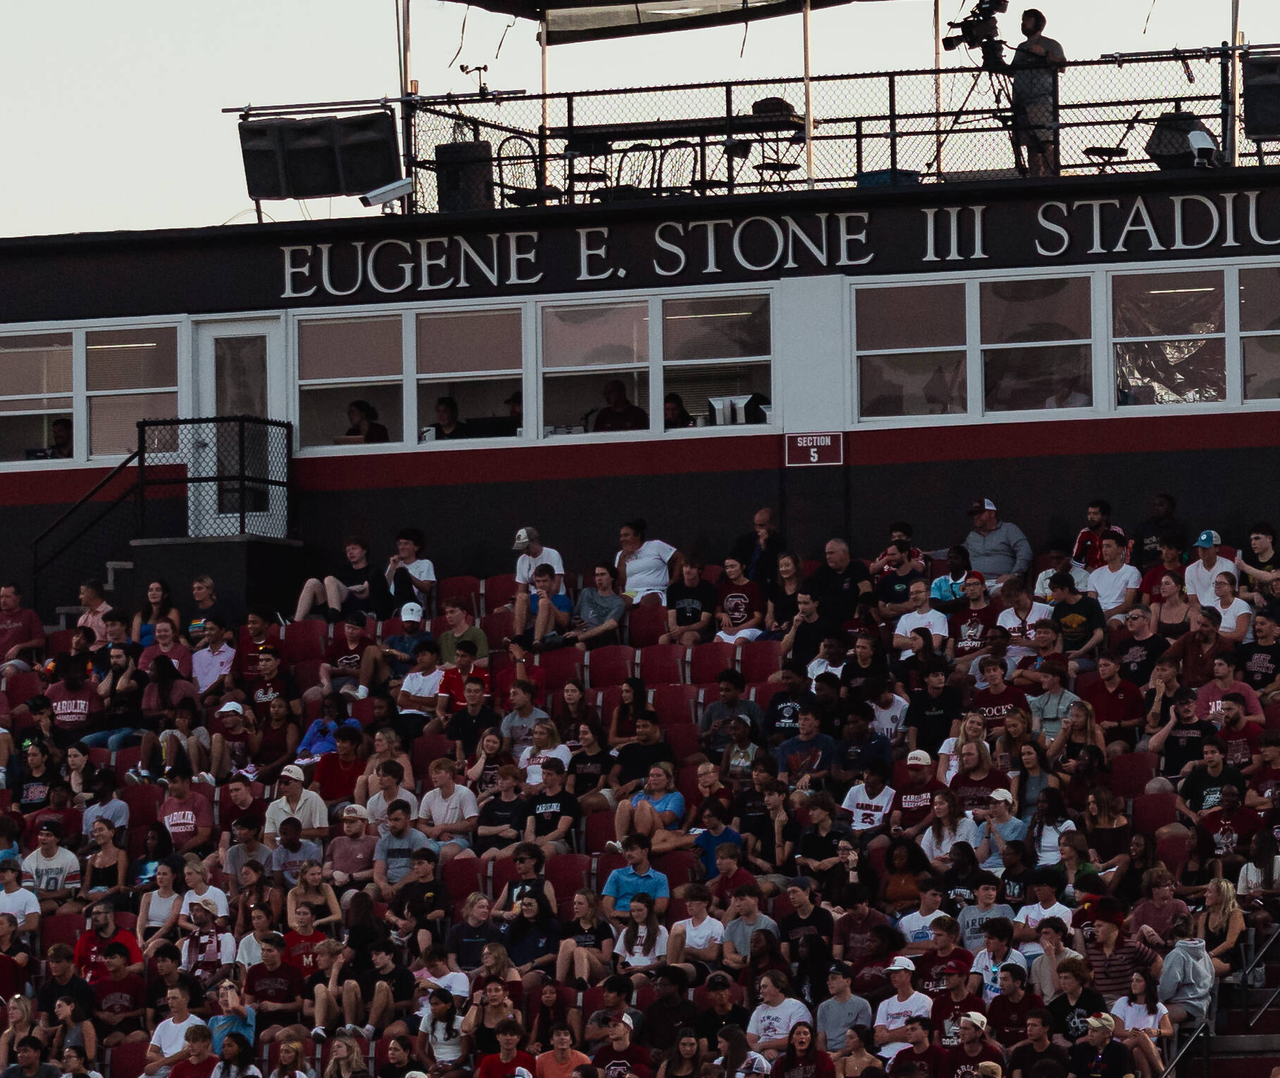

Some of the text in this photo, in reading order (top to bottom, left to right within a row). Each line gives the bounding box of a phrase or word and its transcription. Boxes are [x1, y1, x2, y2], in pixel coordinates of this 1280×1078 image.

[280, 230, 544, 299] EUGENE
[576, 226, 627, 280] E.
[652, 210, 874, 276] STONE
[923, 204, 989, 262] III
[797, 435, 832, 448] SECTION
[810, 447, 820, 463] 5
[52, 700, 89, 717] CAROLINA
[979, 703, 1015, 721] COCKS
[855, 802, 884, 815] CAROLINA
[861, 813, 875, 826] 25
[302, 955, 314, 967] M
